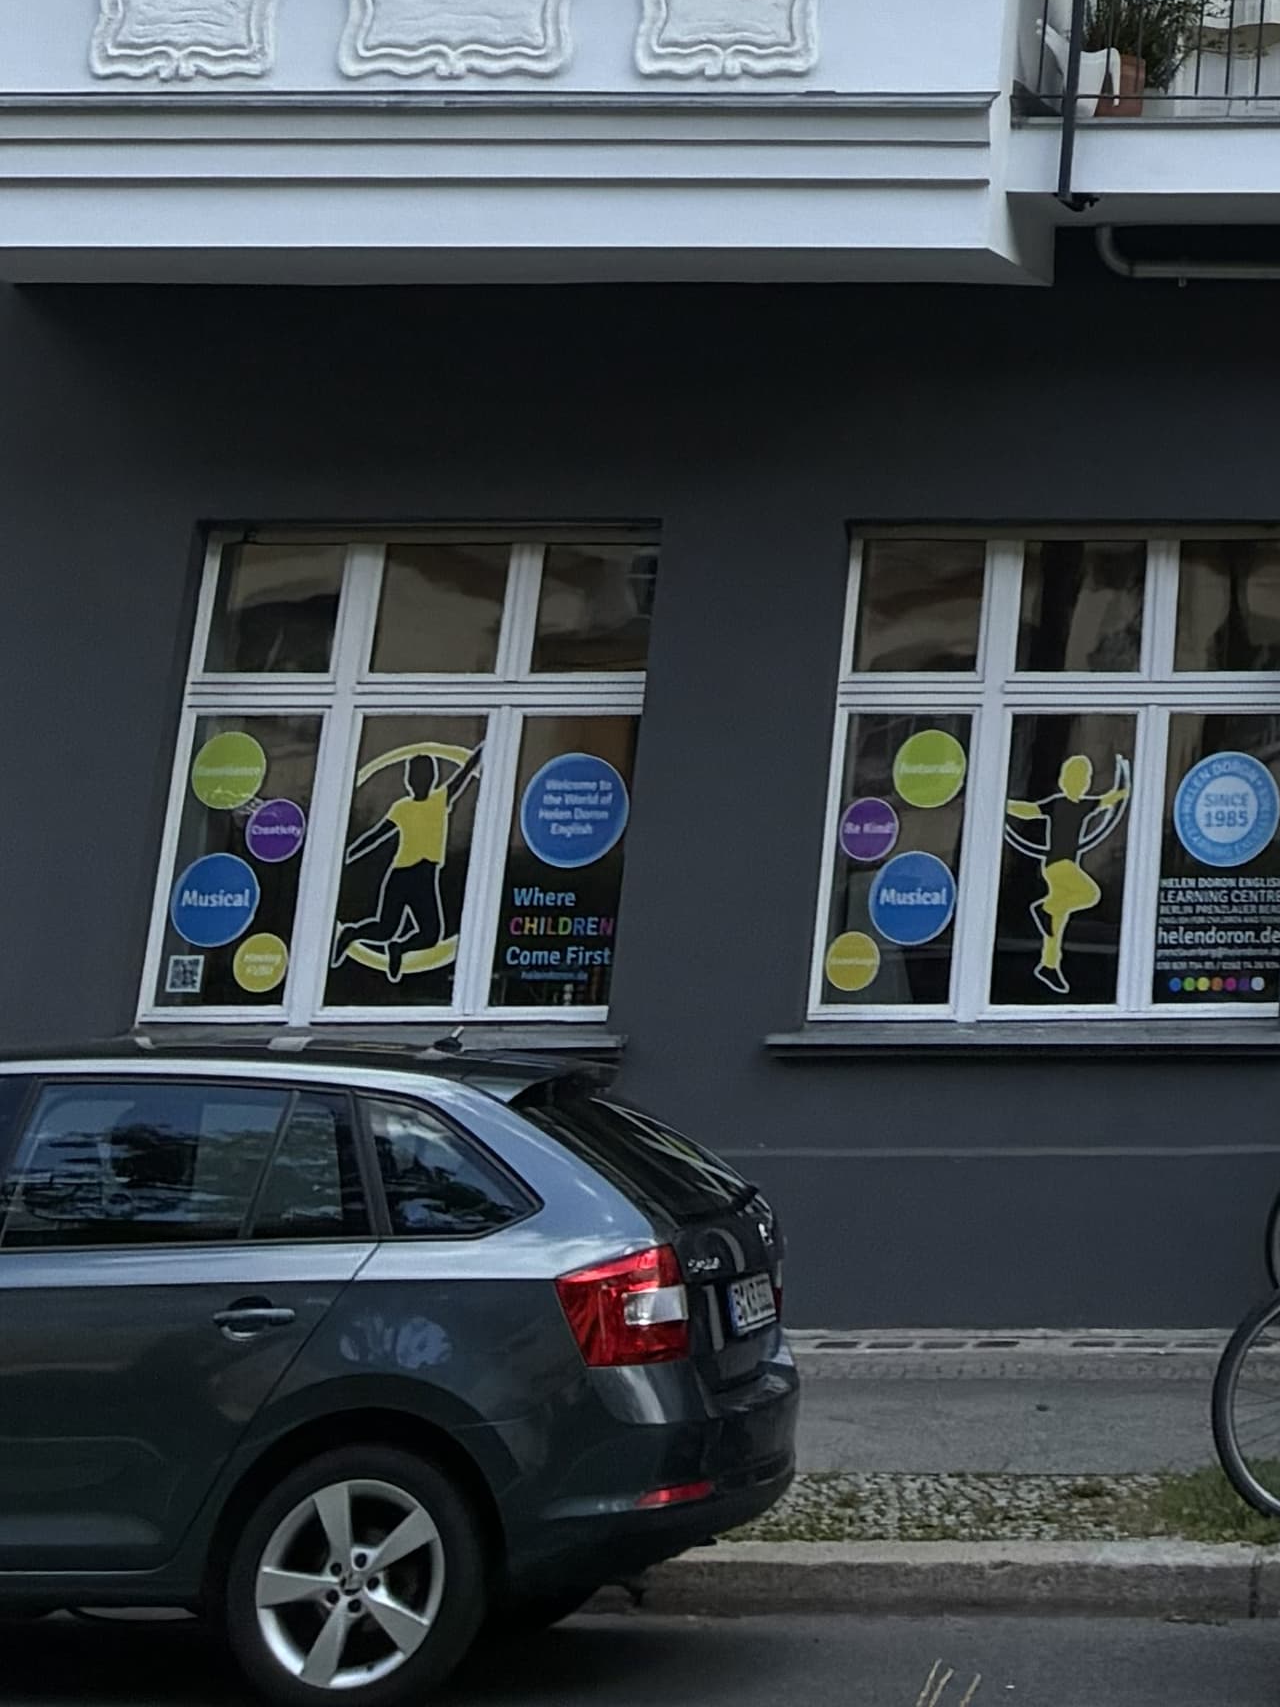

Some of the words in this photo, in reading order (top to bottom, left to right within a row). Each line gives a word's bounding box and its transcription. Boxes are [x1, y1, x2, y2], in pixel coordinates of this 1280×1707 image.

[545, 779, 597, 791] Welcome
[1204, 793, 1249, 808] SINCE
[573, 807, 609, 820] Doron
[1204, 810, 1248, 827] 1985
[550, 822, 593, 838] English
[1197, 877, 1237, 888] DORON
[181, 889, 250, 907] Musical
[513, 886, 576, 907] Where
[879, 888, 948, 906] Musical
[1159, 890, 1229, 903] LEARNING
[509, 916, 616, 936] CHILDREN
[506, 946, 560, 965] Come
[565, 946, 611, 966] First
